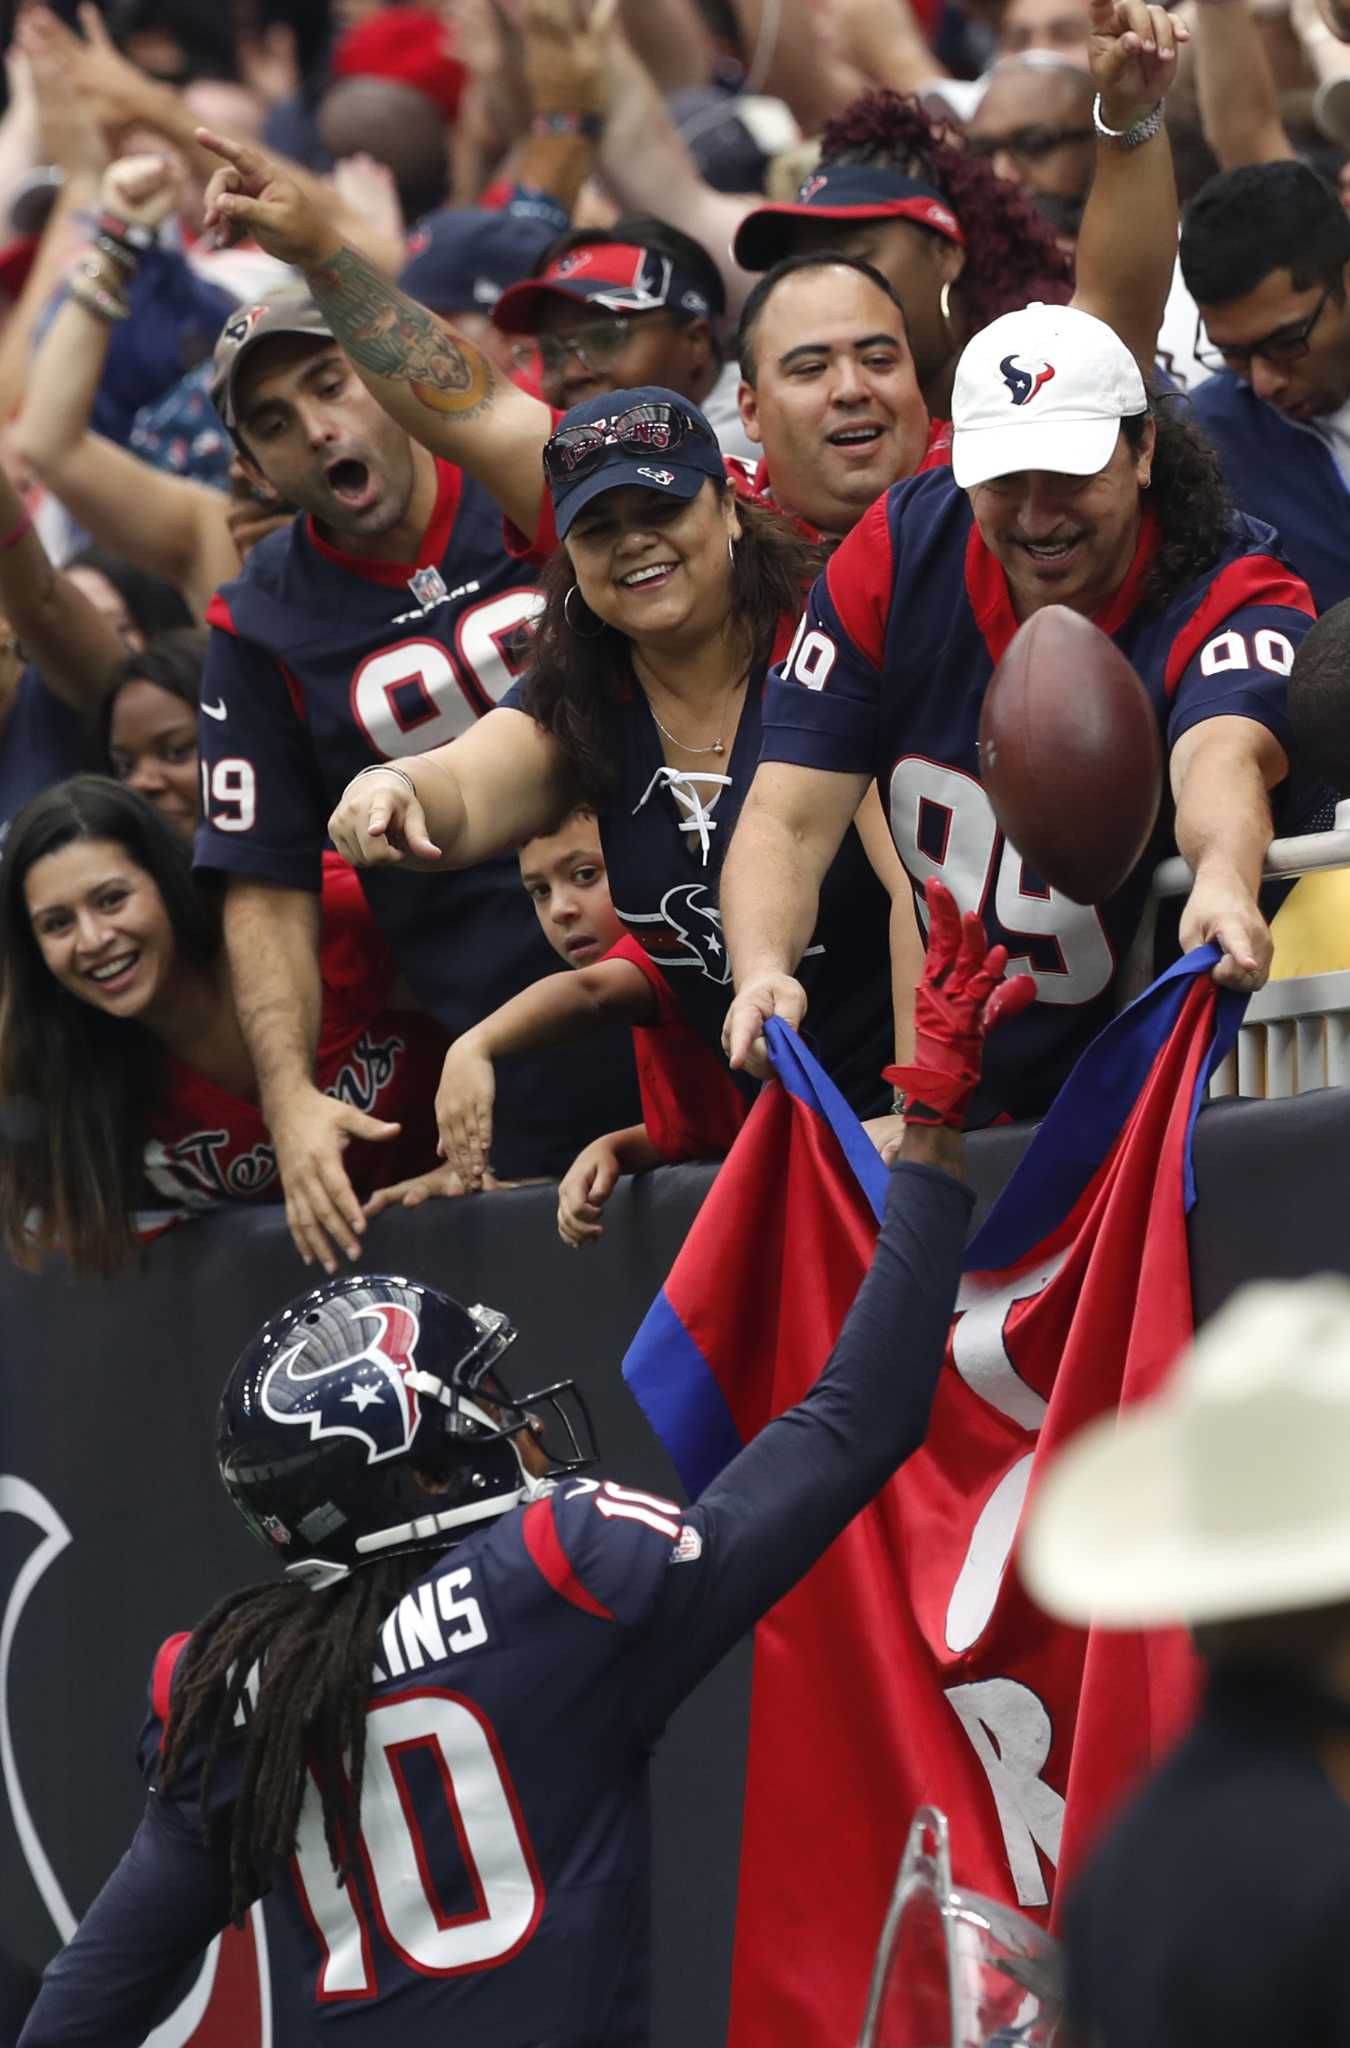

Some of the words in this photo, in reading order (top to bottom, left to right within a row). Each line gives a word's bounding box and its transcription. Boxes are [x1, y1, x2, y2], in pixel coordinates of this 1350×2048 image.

[200, 755, 257, 832] 9
[889, 753, 1116, 1006] 99
[288, 1686, 546, 2001] 10
